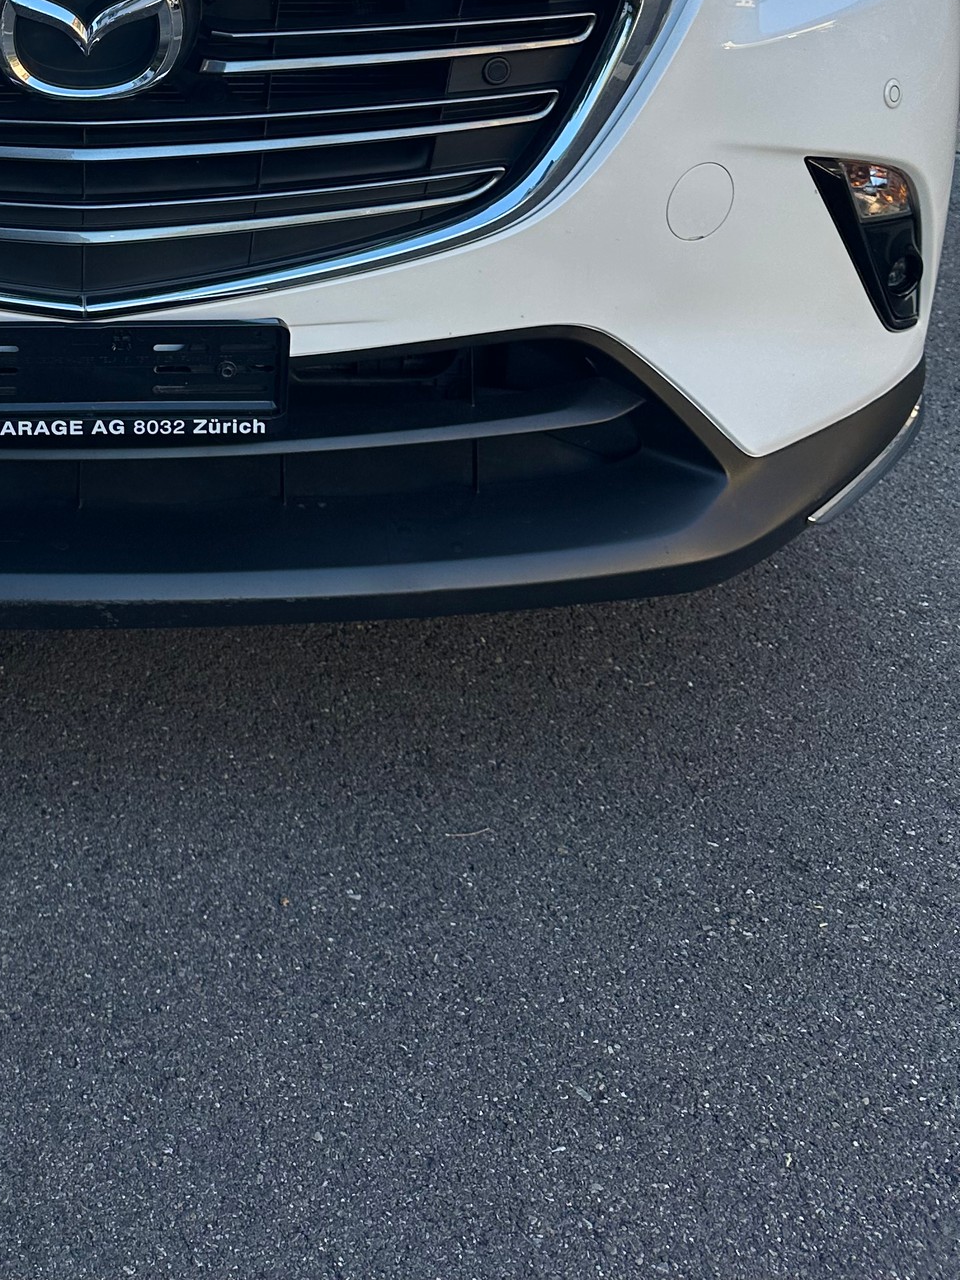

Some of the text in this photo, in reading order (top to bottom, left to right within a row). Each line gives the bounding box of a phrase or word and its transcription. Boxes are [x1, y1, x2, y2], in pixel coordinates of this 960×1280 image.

[91, 420, 125, 436] AG
[133, 420, 186, 435] 8032
[193, 419, 267, 435] Zürich
